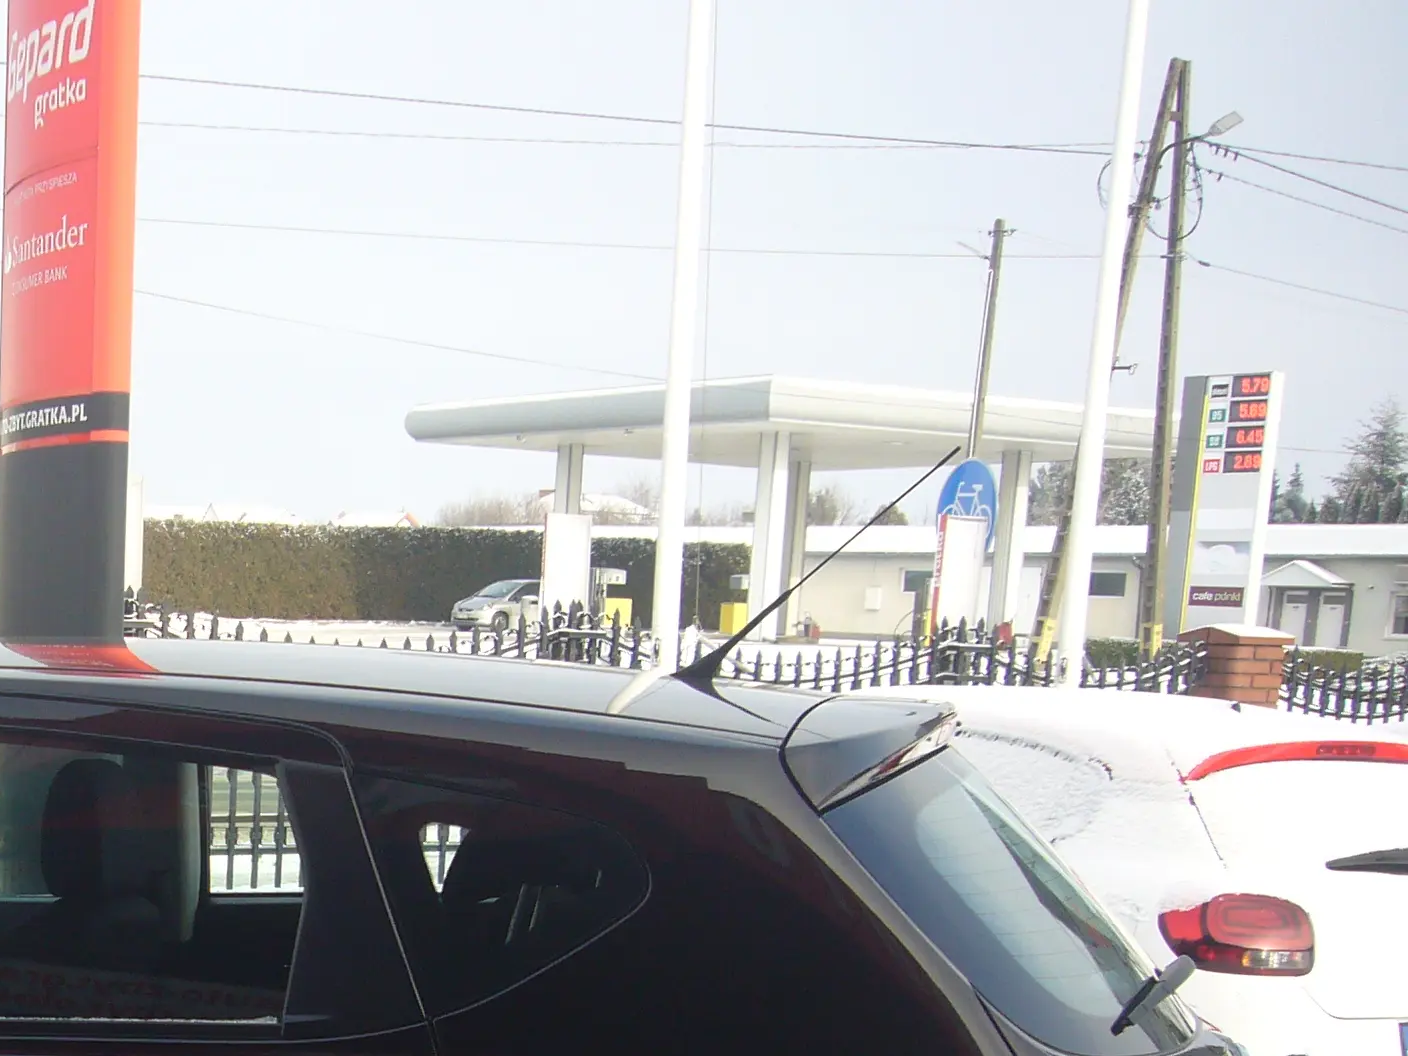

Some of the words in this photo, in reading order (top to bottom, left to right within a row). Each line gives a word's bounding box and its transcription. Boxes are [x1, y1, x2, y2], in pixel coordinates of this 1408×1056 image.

[34, 77, 86, 130] gratka
[12, 213, 89, 268] Santander
[44, 265, 68, 285] BANK
